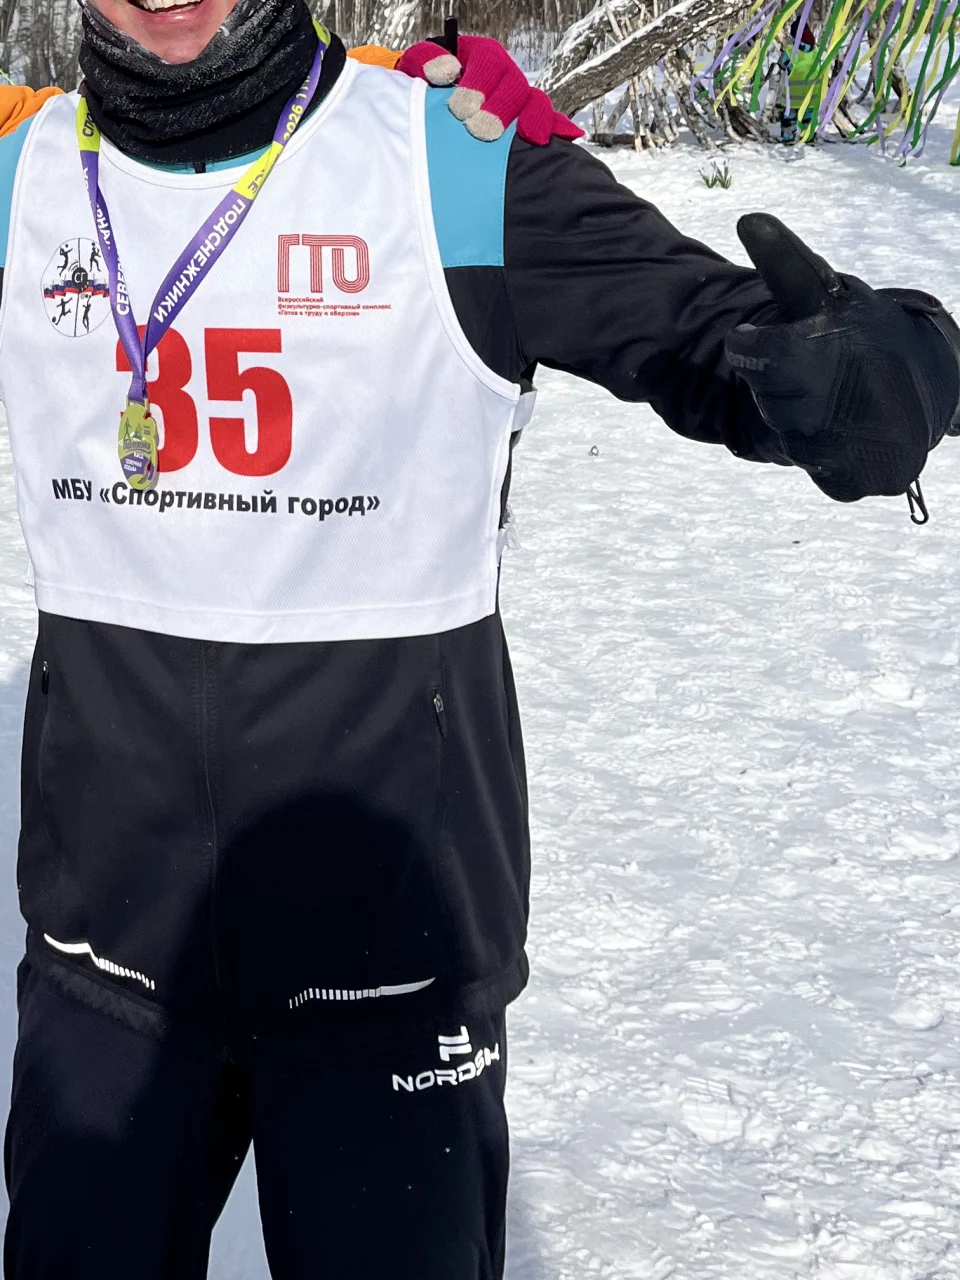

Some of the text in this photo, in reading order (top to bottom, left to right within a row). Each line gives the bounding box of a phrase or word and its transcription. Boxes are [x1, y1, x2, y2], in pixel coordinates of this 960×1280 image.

[153, 198, 247, 324] ПОДСНЕЖНИКИ
[277, 233, 370, 294] ГТО
[114, 324, 294, 477] 35
[51, 478, 381, 521] МБУ «Спортивный город»
